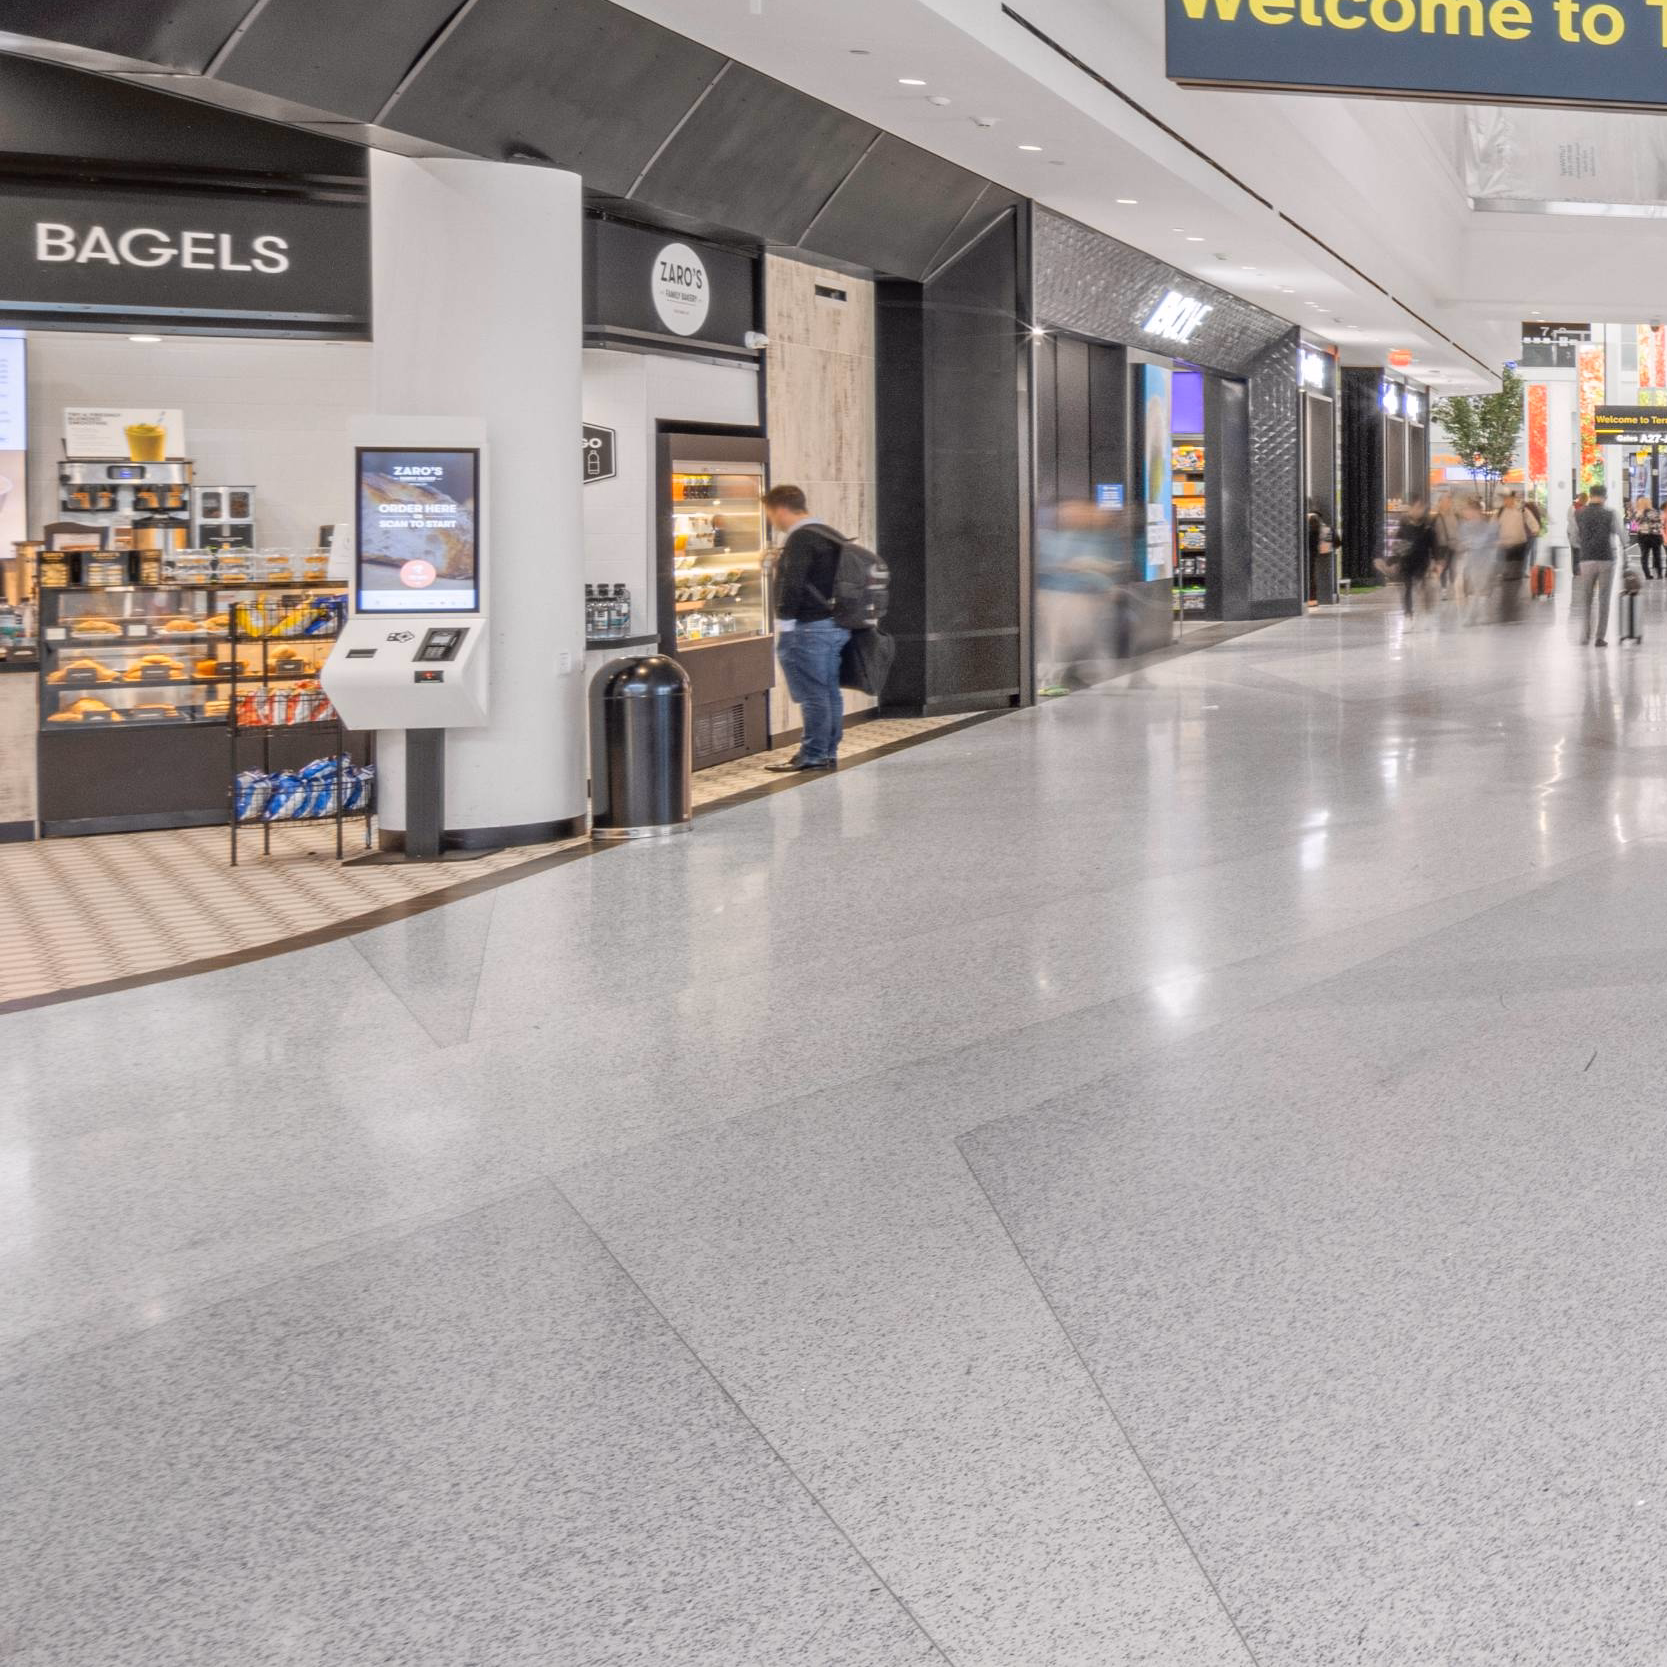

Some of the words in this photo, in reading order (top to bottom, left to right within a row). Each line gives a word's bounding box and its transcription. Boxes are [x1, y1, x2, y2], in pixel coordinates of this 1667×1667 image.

[35, 221, 290, 274] BAGELS
[660, 260, 703, 290] ZARO'S
[1595, 415, 1638, 424] Welcome
[1640, 415, 1649, 424] to
[393, 466, 443, 476] ZARO'S
[378, 504, 423, 513] ORDER
[425, 504, 457, 513] HERE
[378, 520, 408, 528] SCAN
[409, 520, 424, 528] TO
[426, 520, 457, 528] START
